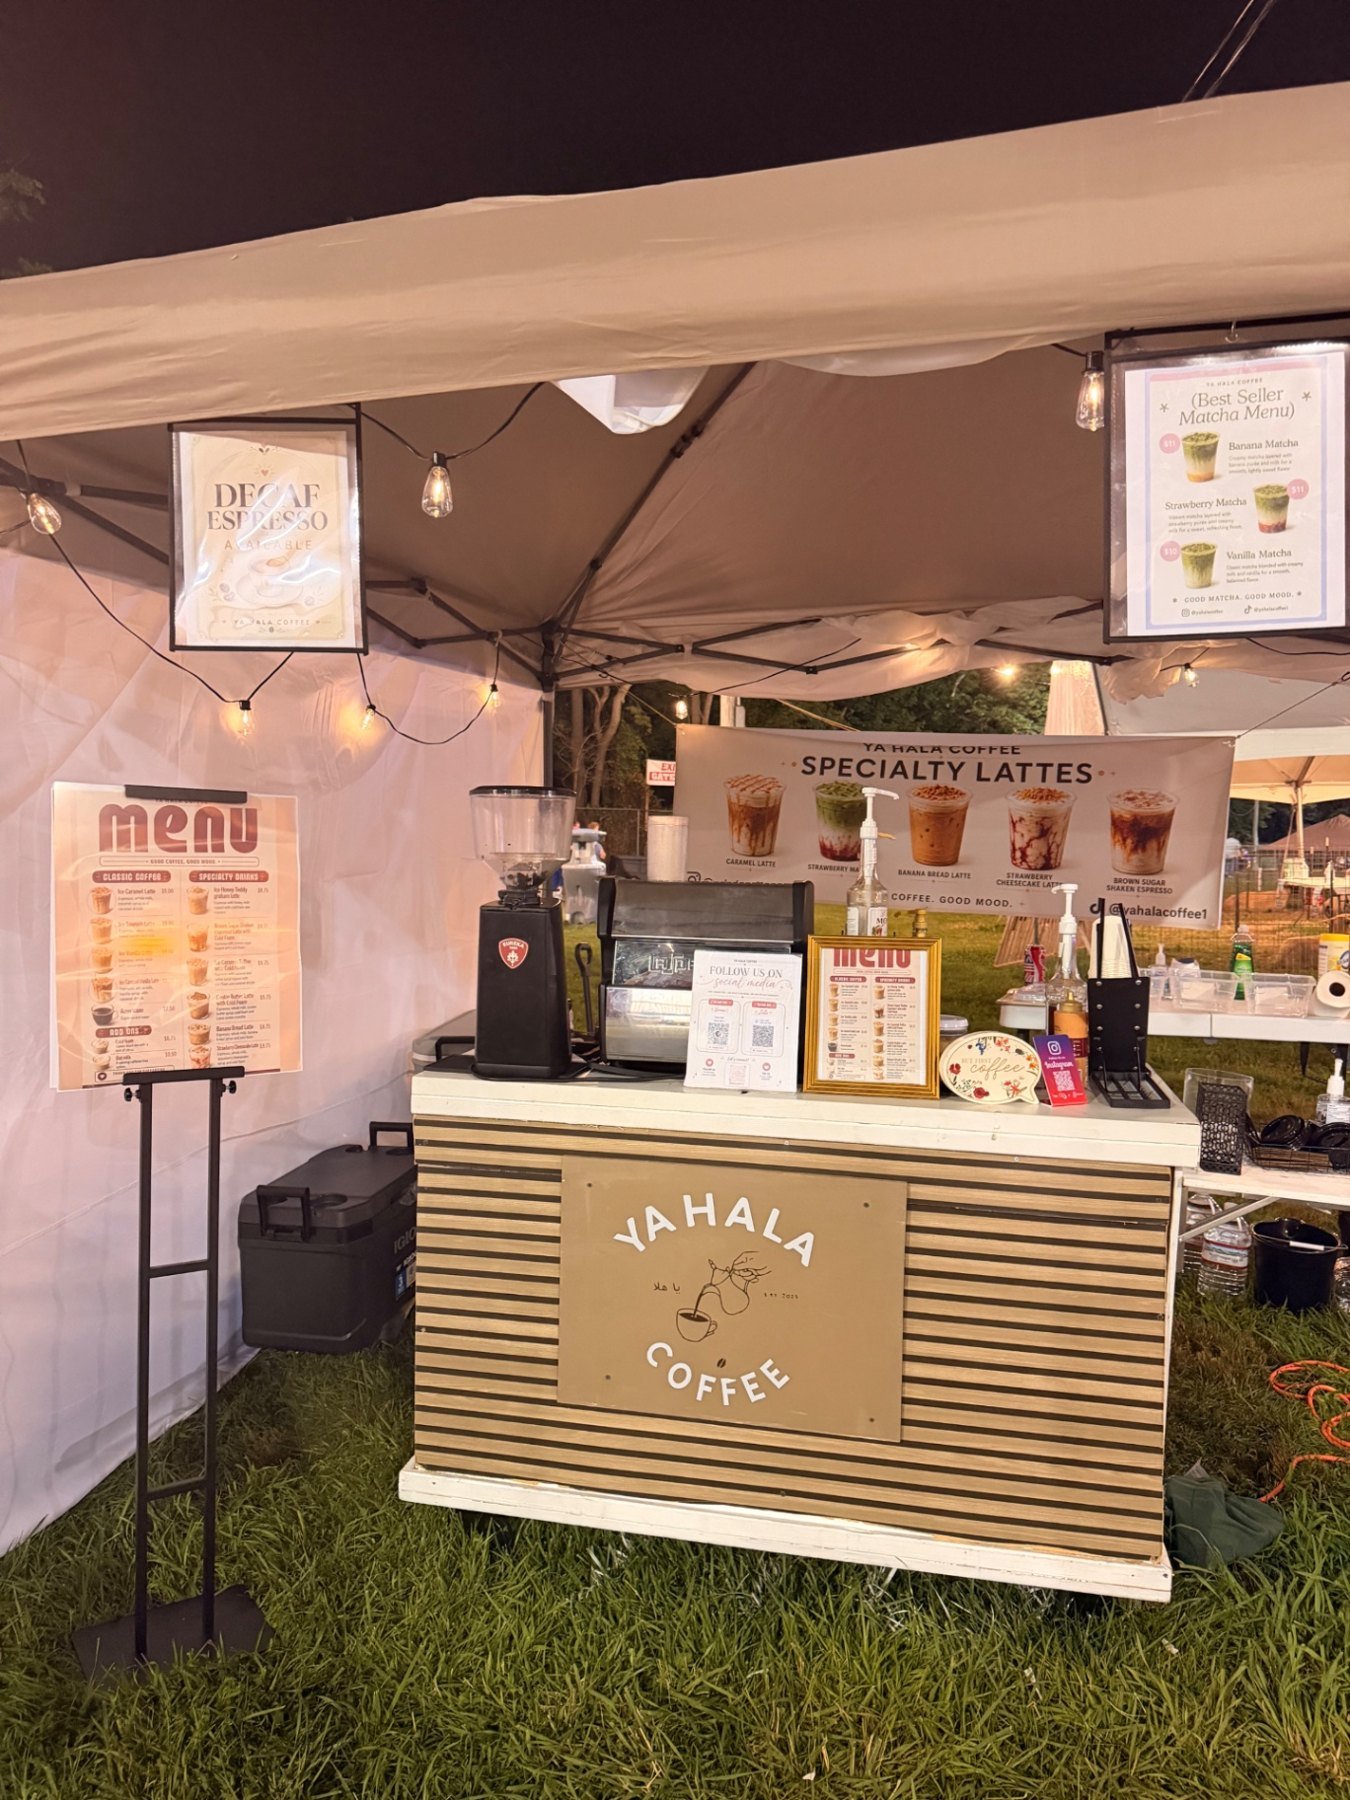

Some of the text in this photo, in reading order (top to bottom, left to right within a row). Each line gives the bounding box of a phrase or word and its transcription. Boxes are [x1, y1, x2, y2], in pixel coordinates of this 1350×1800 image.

[1191, 387, 1284, 410] (Best Seller
[1178, 402, 1296, 426] Matcha Menu)
[1228, 438, 1299, 452] Banana Matcha
[214, 482, 320, 508] DECAF
[1291, 484, 1304, 494] $11
[1165, 497, 1247, 511] Strawberry Matcha
[207, 510, 328, 531] ESPRESSO
[1226, 550, 1291, 560] Vanilla Matcha
[863, 743, 1021, 755] YA HALA COFFEE
[801, 756, 1093, 784] SPECIALTY LATTES
[726, 858, 776, 868] CARAMEL LATTE
[808, 863, 848, 873] STRAWBERRY
[898, 869, 926, 877] BANANA
[927, 871, 950, 879] BREAD
[1006, 872, 1053, 881] STRAWBERRY
[996, 879, 1041, 888] CHEESECAKE
[1141, 878, 1166, 886] SUGAR
[891, 893, 1012, 908] COFFEE. GOOD MOOD.
[1109, 903, 1207, 919] @yahalacoffee1
[709, 966, 784, 978] FOLLOW US ON
[970, 1057, 1025, 1080] coffee
[1044, 1061, 1074, 1070] Instagram
[394, 1226, 416, 1255] IGLO
[646, 1341, 790, 1406] COFFEE
